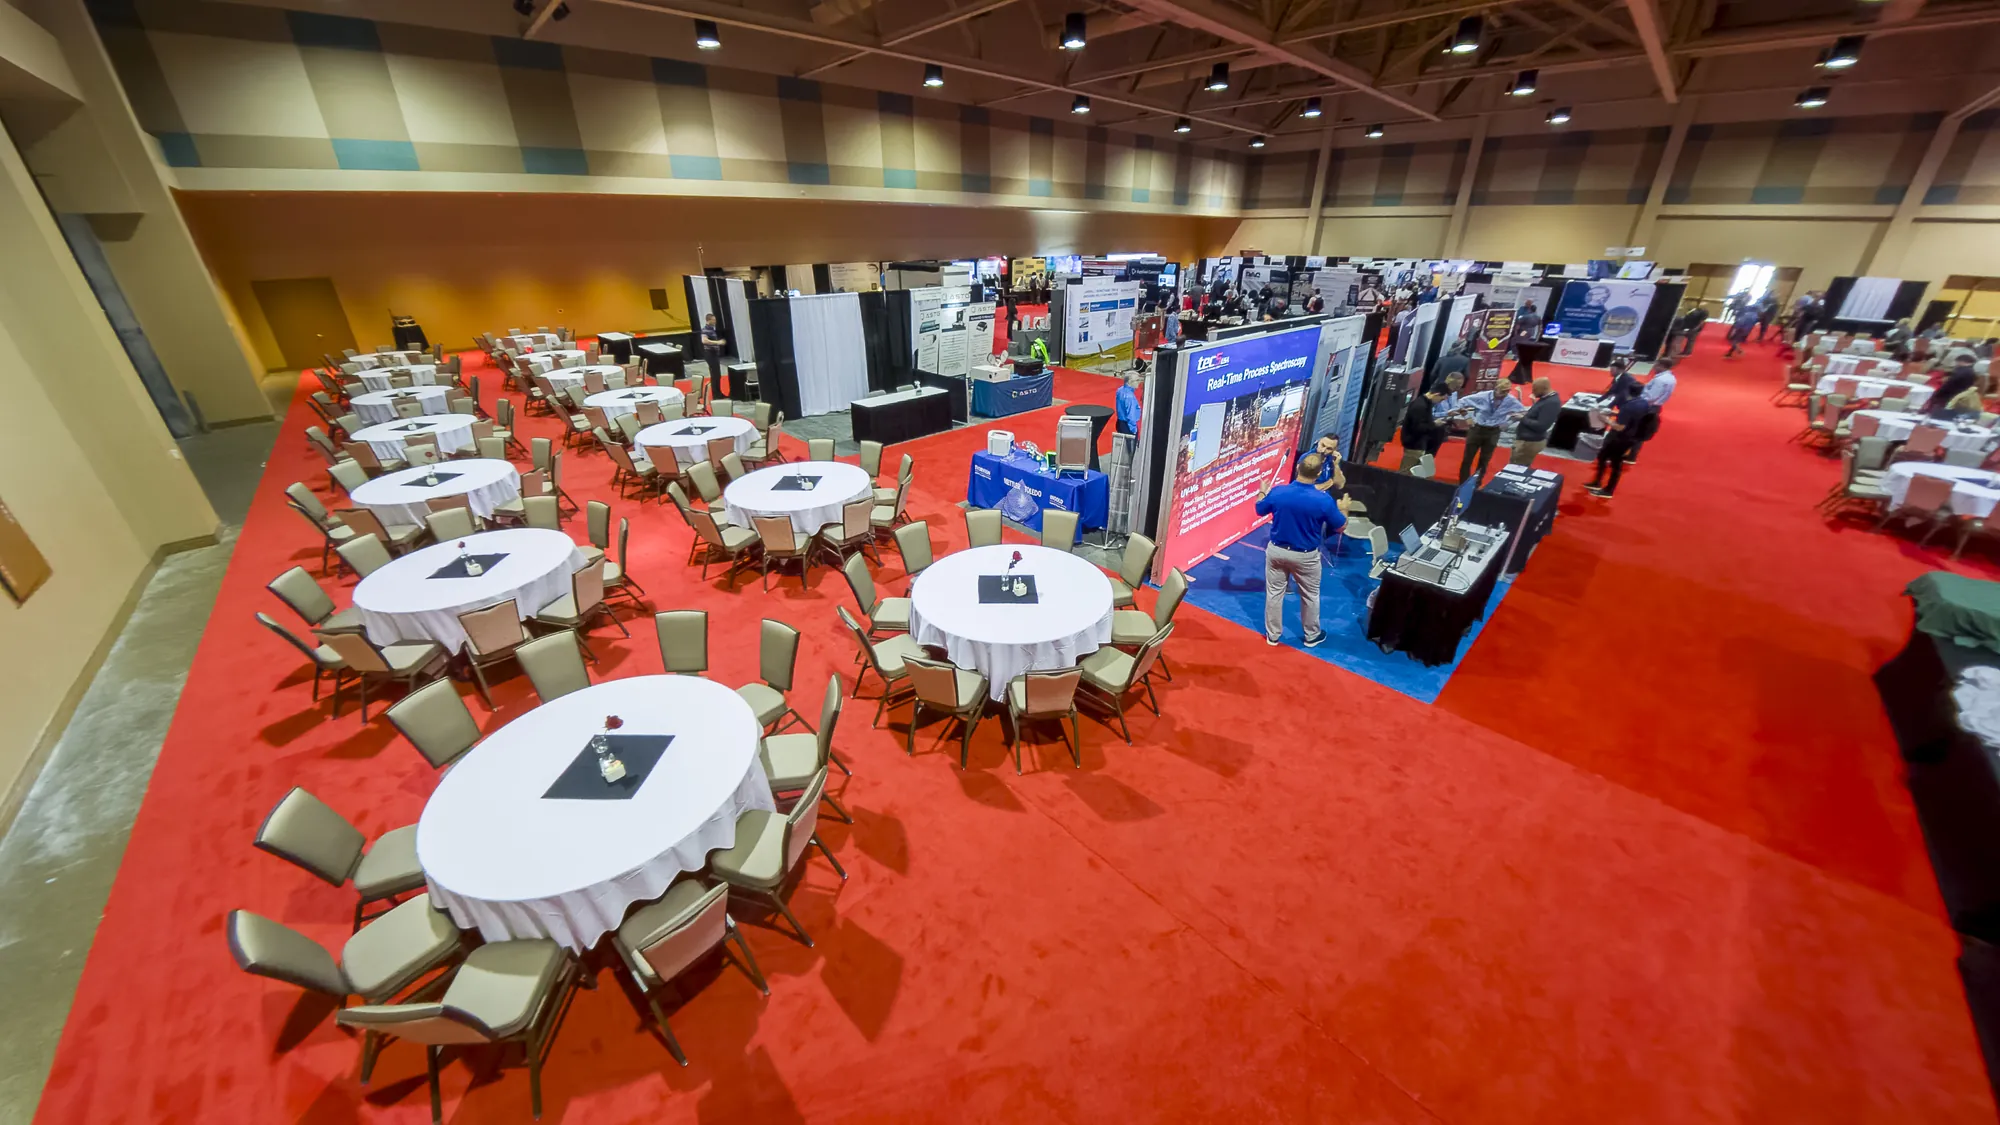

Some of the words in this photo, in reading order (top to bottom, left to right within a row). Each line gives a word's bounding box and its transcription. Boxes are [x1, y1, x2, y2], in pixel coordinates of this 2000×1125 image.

[1207, 372, 1242, 391] Real-Time
[1243, 364, 1269, 380] Process
[1270, 356, 1307, 375] Spectroscopy
[1181, 484, 1198, 498] UV-Vis
[1203, 477, 1212, 486] NIR
[1234, 461, 1251, 474] Process
[1252, 449, 1279, 465] Spectroscopy
[1025, 486, 1042, 497] TOLEDO
